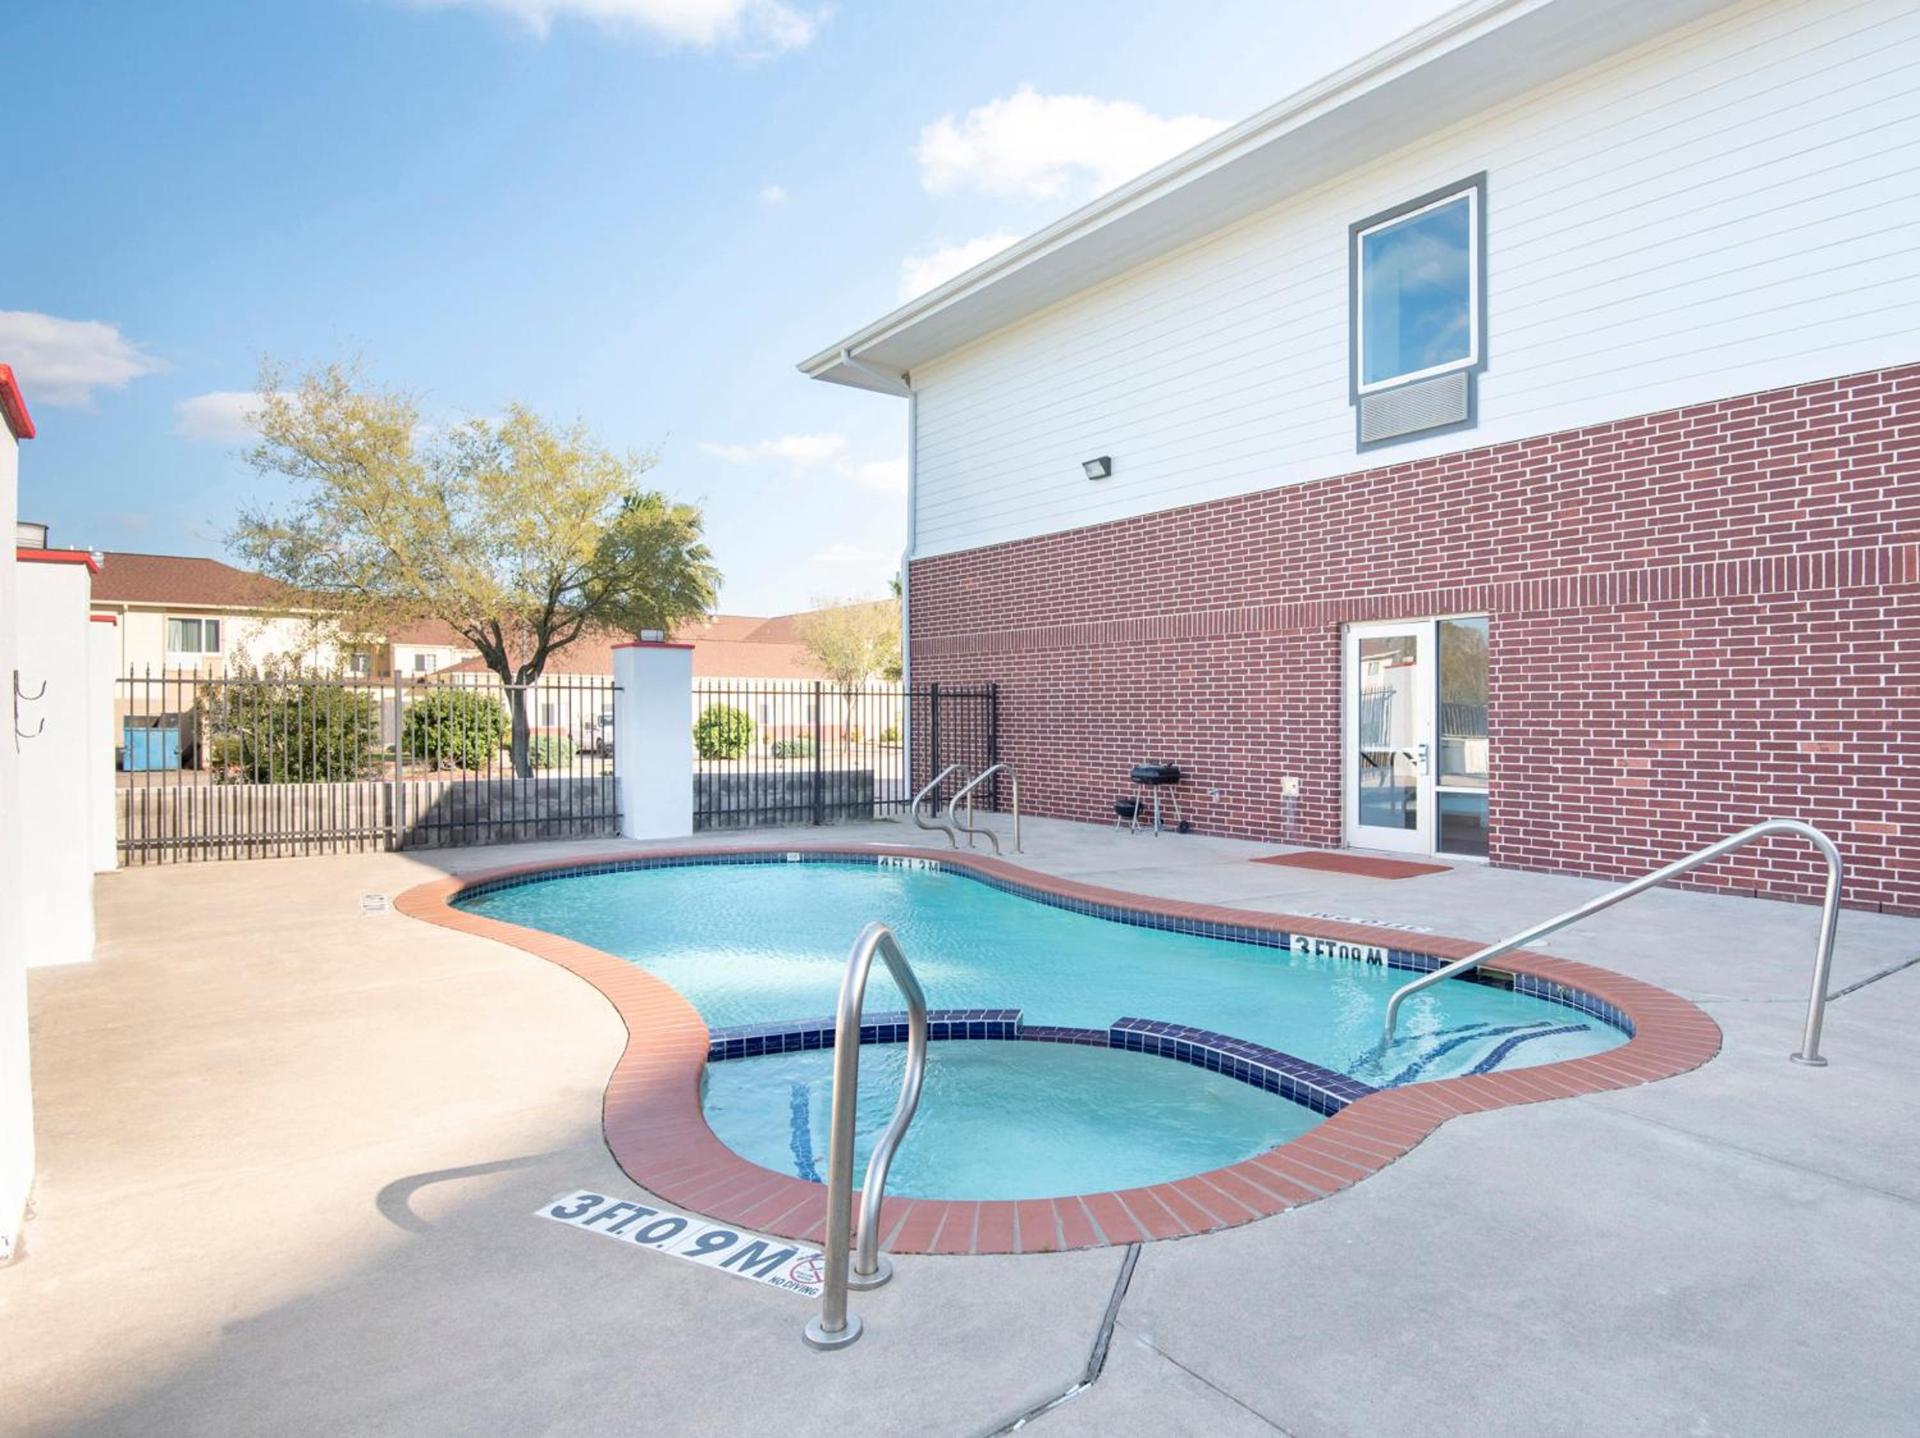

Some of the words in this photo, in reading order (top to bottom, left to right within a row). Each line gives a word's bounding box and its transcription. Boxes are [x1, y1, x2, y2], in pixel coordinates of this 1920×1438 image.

[1295, 937, 1310, 954] 3
[1315, 940, 1337, 958] FT
[550, 1194, 605, 1219] 3
[719, 1240, 798, 1278] M
[767, 1275, 785, 1286] NO
[782, 1280, 819, 1296] DIVING
